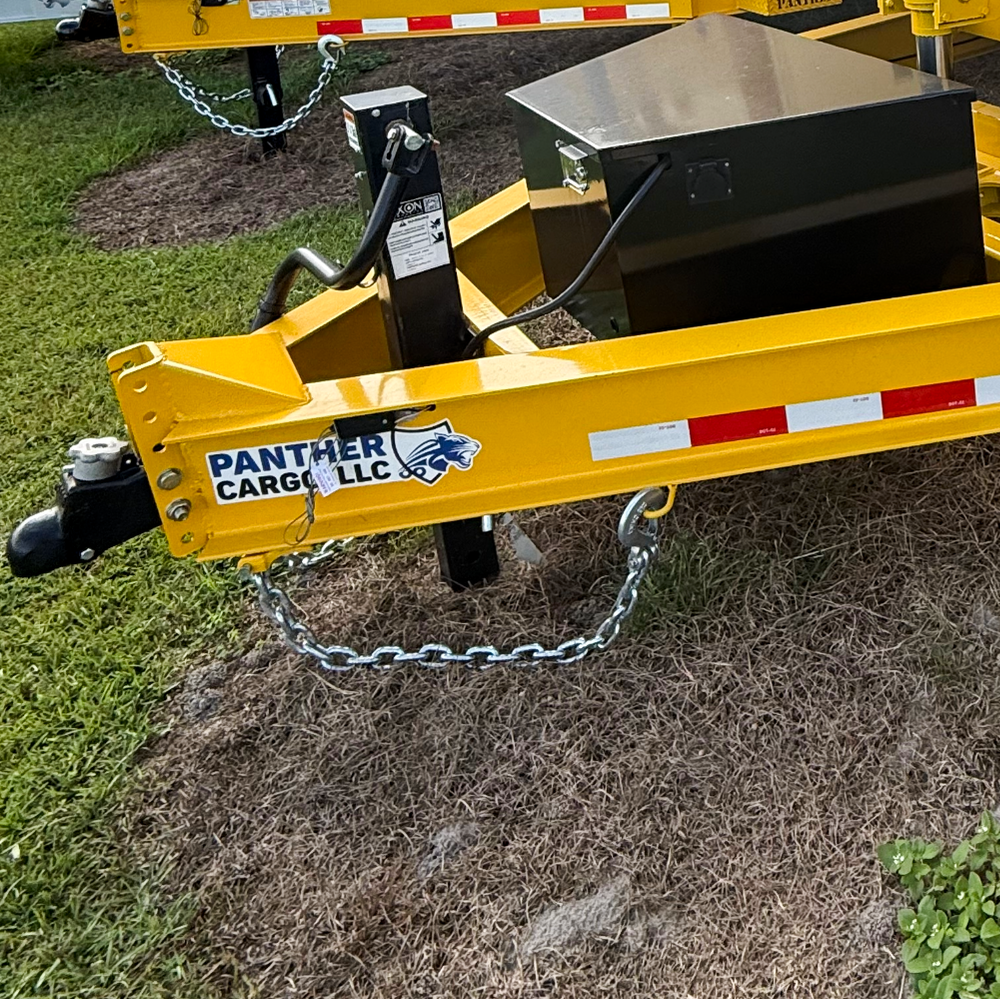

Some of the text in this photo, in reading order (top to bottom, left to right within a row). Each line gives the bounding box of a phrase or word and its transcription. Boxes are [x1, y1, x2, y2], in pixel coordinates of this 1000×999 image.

[208, 433, 388, 478] PANTHER
[216, 469, 320, 500] CARGO
[336, 460, 392, 485] LLC
